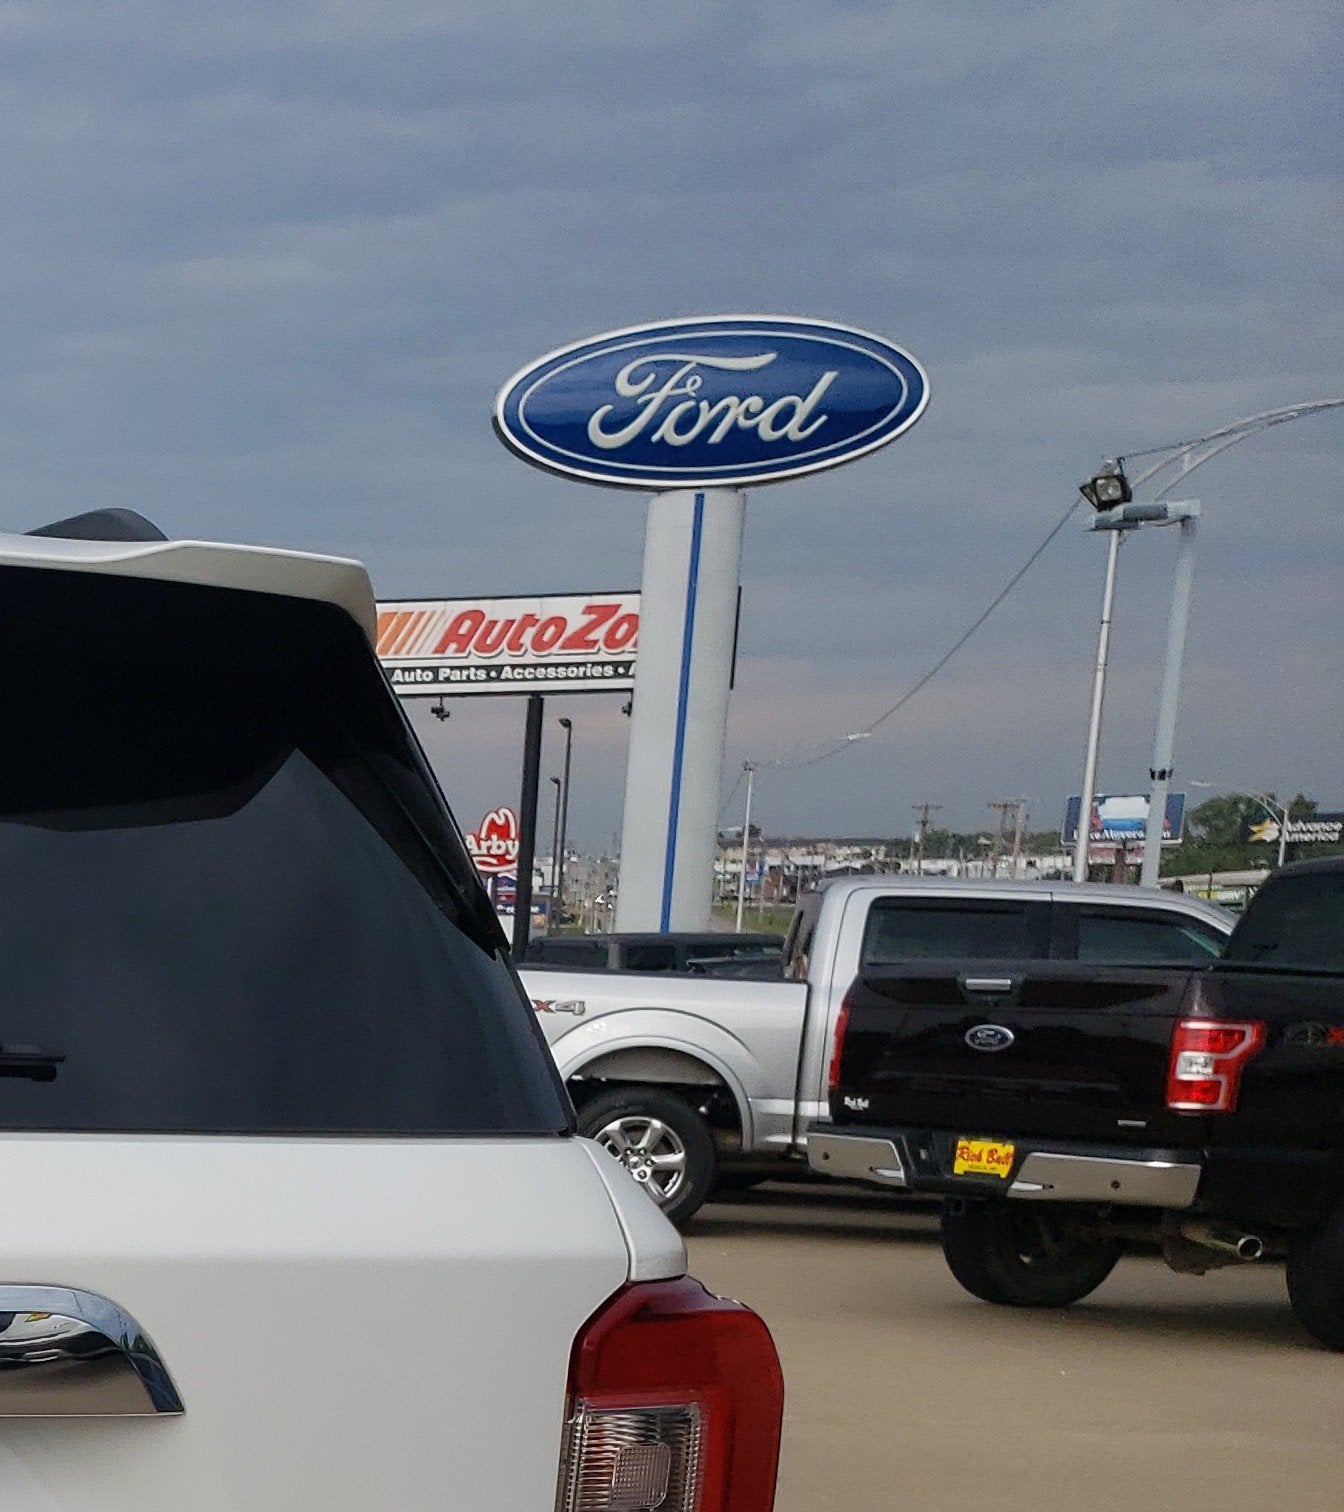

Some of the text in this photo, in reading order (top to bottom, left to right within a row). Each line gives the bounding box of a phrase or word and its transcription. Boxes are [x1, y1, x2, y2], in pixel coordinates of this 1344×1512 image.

[588, 352, 839, 450] Ford
[432, 604, 639, 654] AutoZo
[391, 669, 433, 683] Auto
[438, 667, 488, 682] Parts
[500, 662, 615, 681] Accessories
